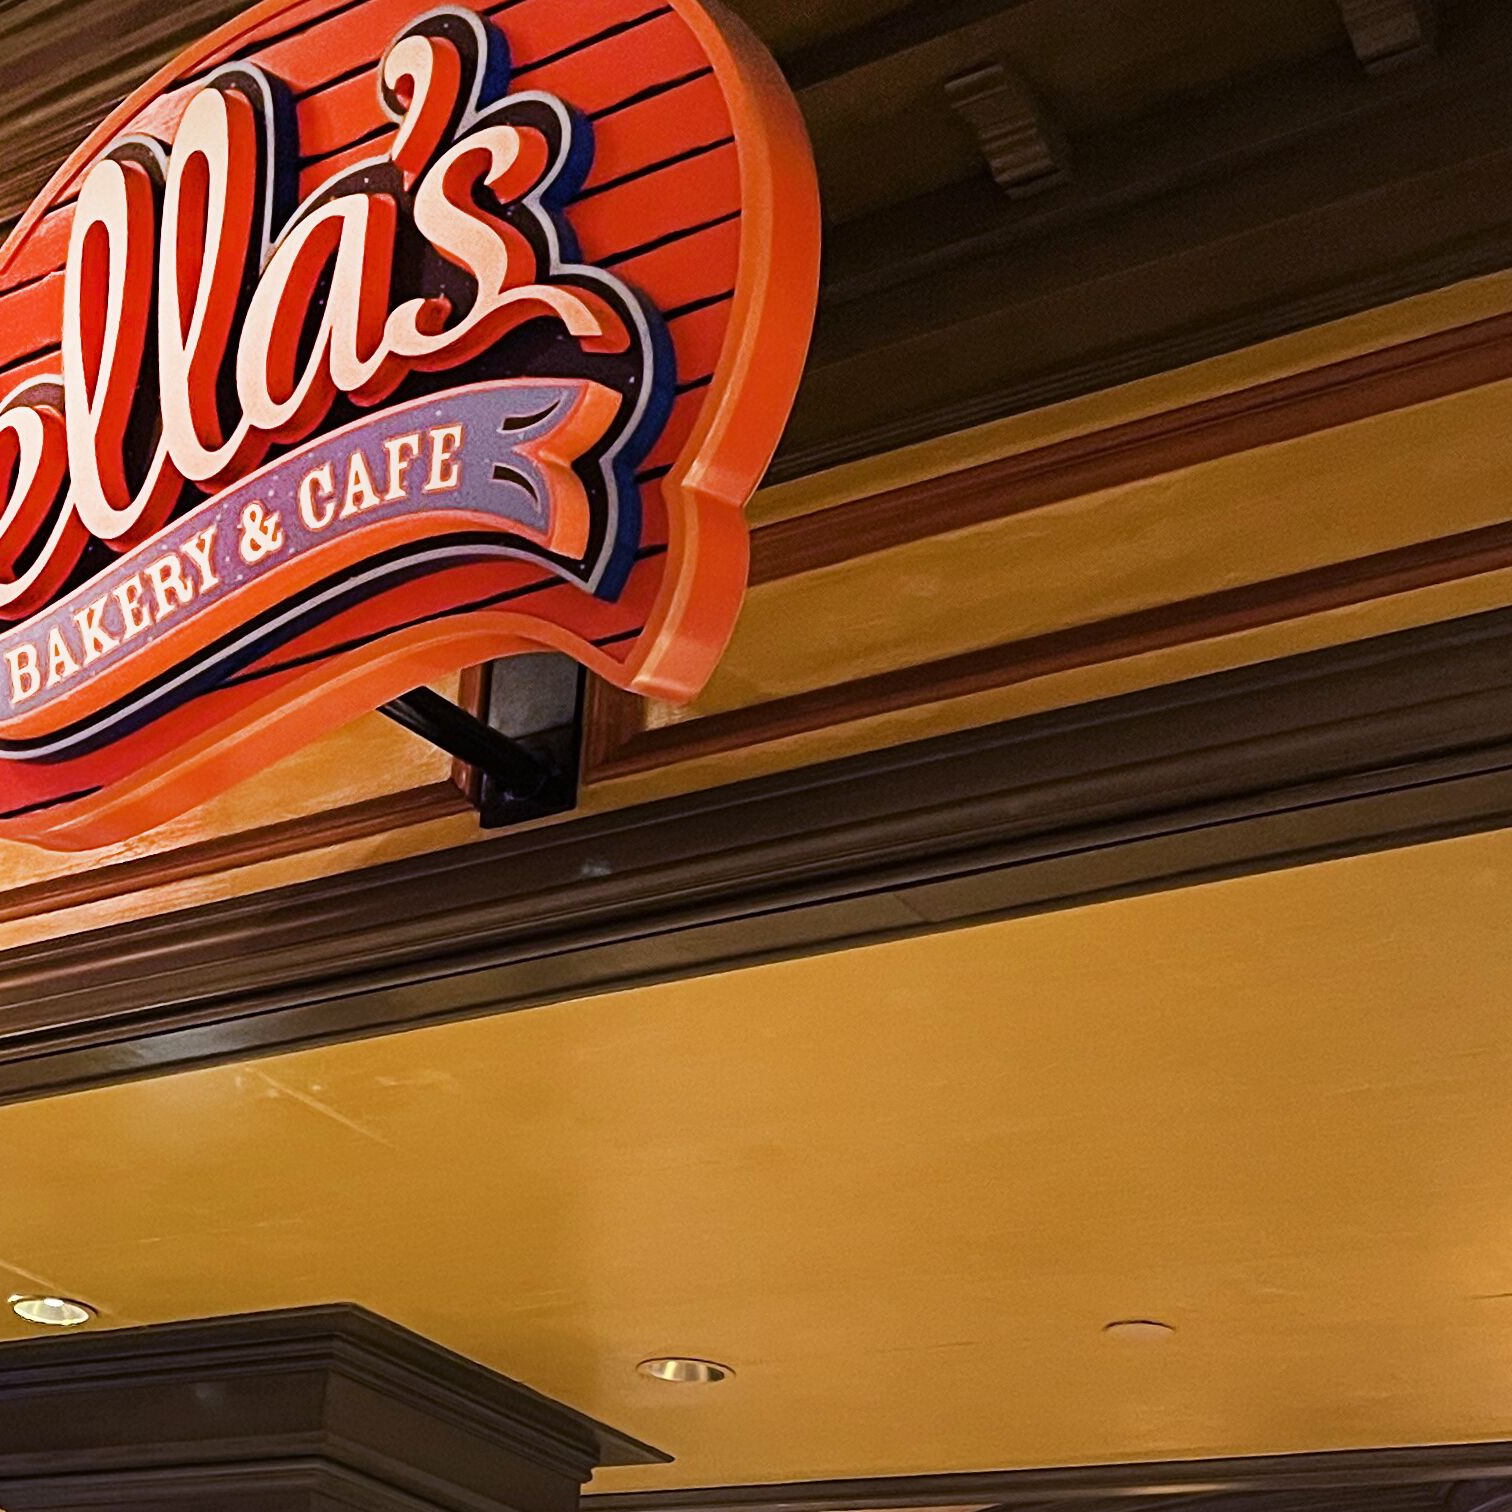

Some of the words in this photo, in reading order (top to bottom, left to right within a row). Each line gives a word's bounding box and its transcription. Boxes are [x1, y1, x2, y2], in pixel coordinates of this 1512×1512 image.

[5, 523, 218, 705] BAKERY
[238, 500, 283, 566] &
[298, 423, 463, 533] CAFE
